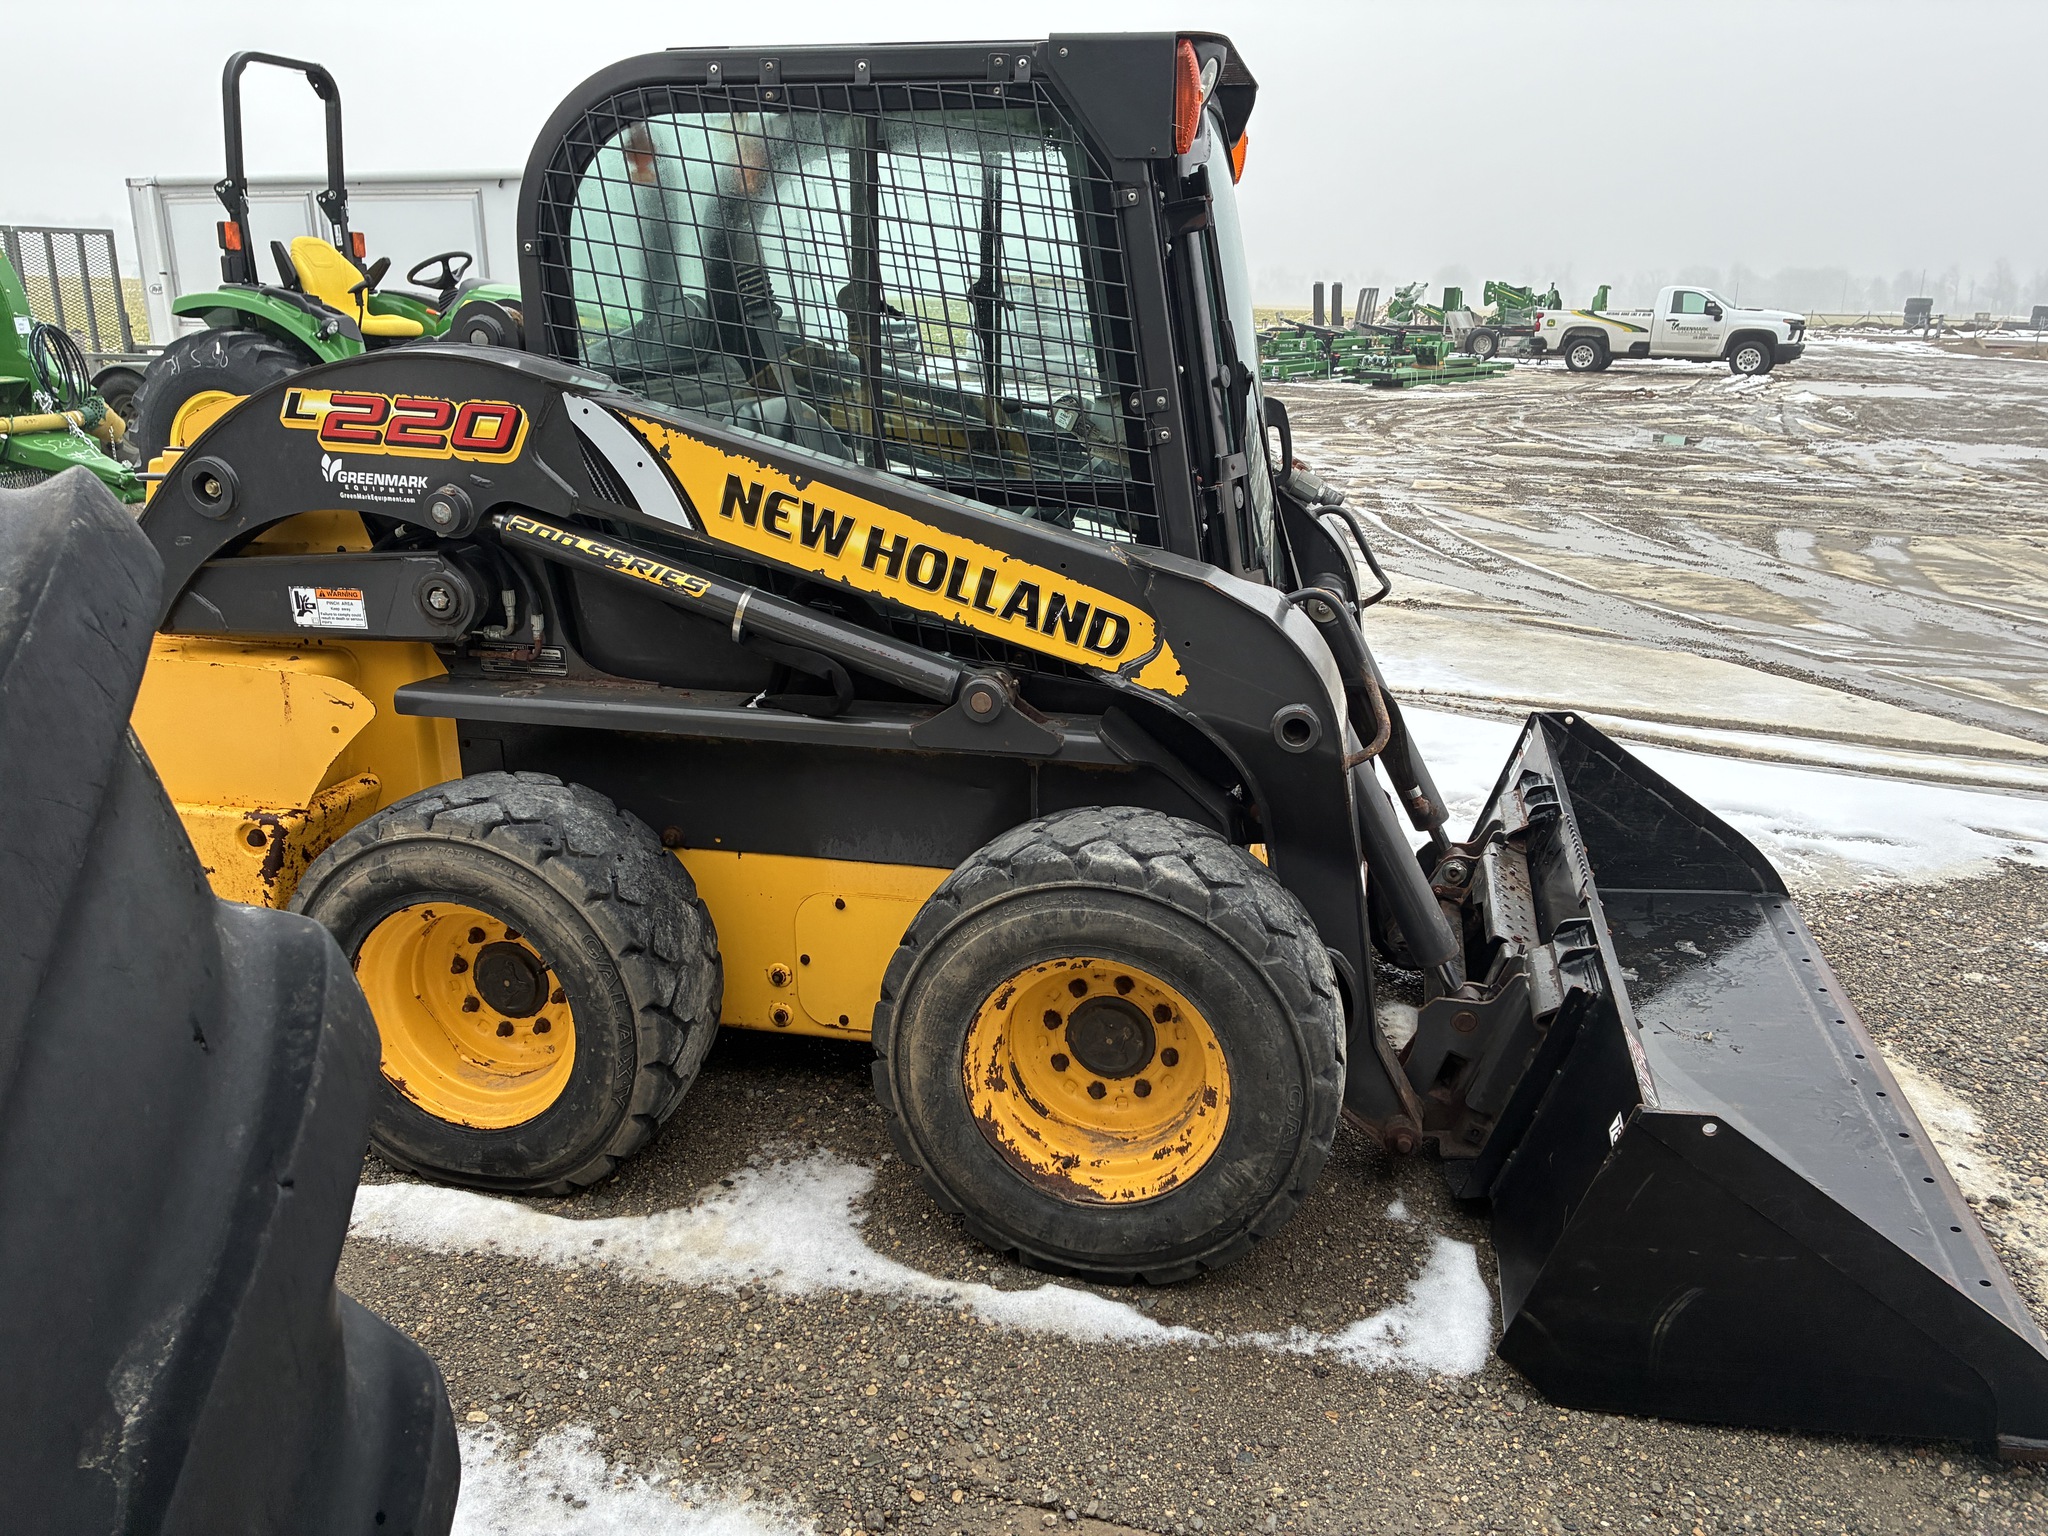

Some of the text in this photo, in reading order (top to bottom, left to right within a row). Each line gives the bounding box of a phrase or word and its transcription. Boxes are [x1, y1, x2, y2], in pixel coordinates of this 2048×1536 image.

[337, 470, 428, 489] GREENMARK
[344, 484, 422, 495] EQUIPMENT
[339, 491, 416, 504] GreenMarkEquipment.com
[718, 472, 1133, 657] NEW HOLLAND
[945, 913, 994, 949] THE
[580, 932, 637, 1110] GALAXY
